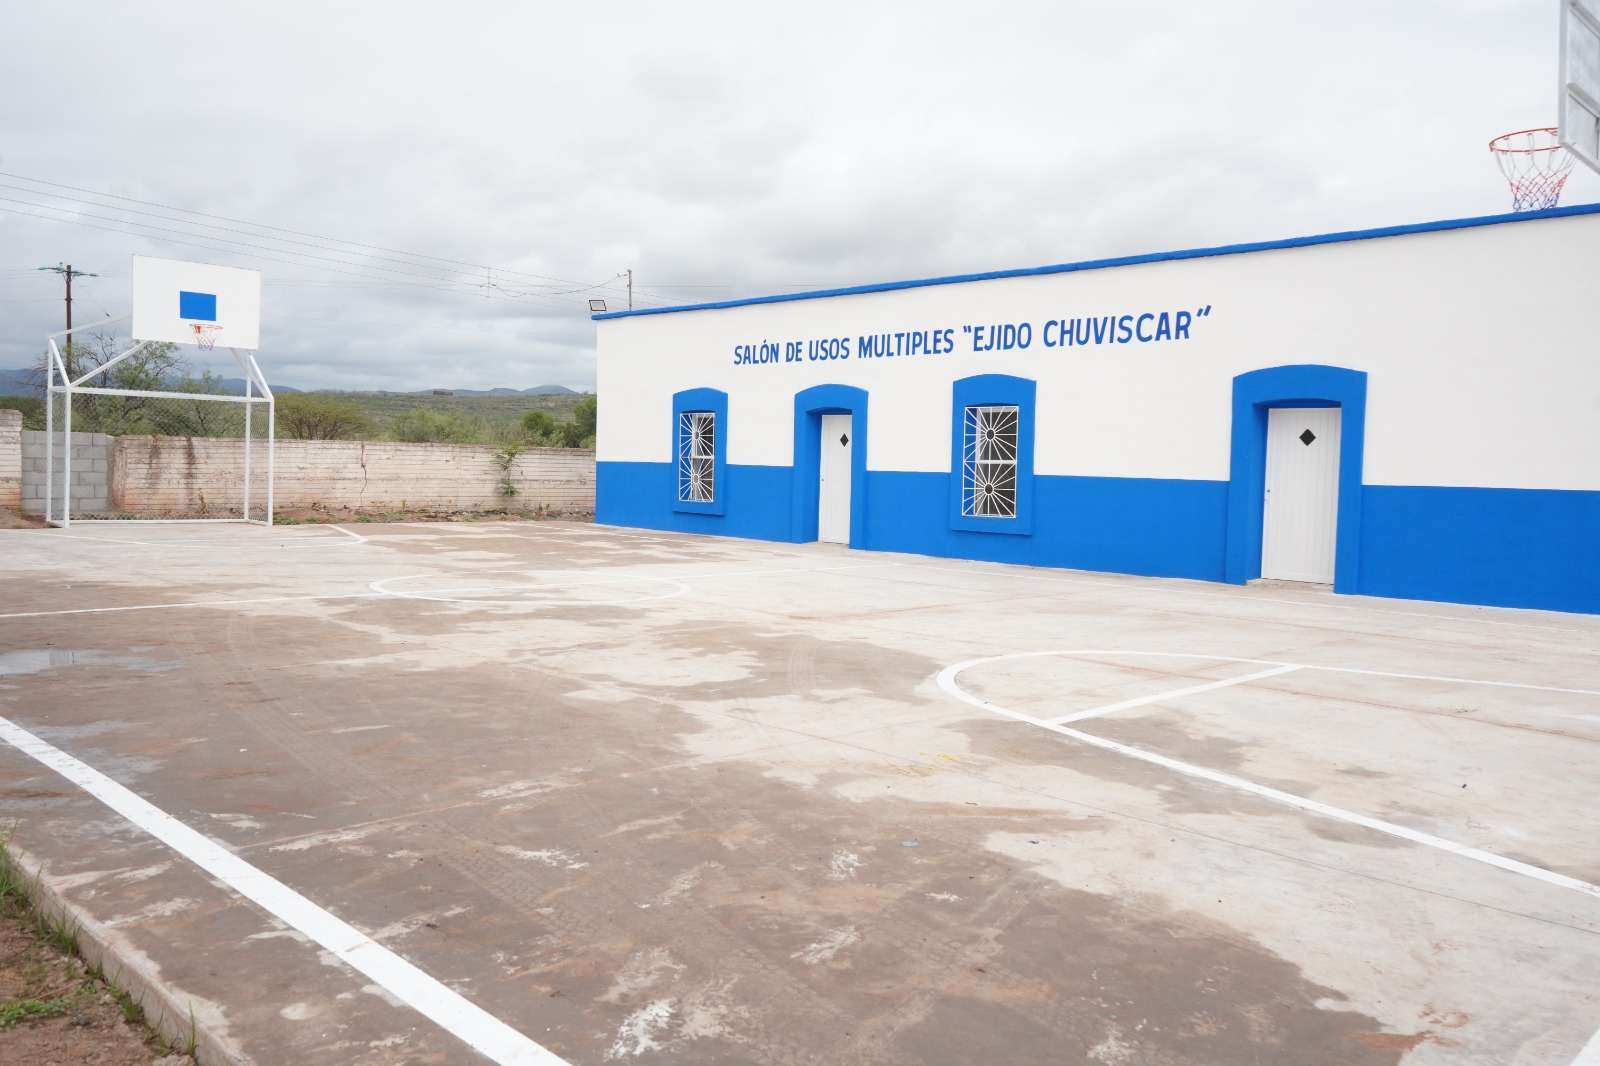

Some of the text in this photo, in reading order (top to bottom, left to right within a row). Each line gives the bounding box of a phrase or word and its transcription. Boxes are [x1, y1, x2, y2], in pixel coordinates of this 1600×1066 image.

[733, 339, 780, 365] SALÓN
[785, 341, 803, 363] DE
[808, 337, 850, 361] USOS
[857, 328, 955, 359] MULTIPLES
